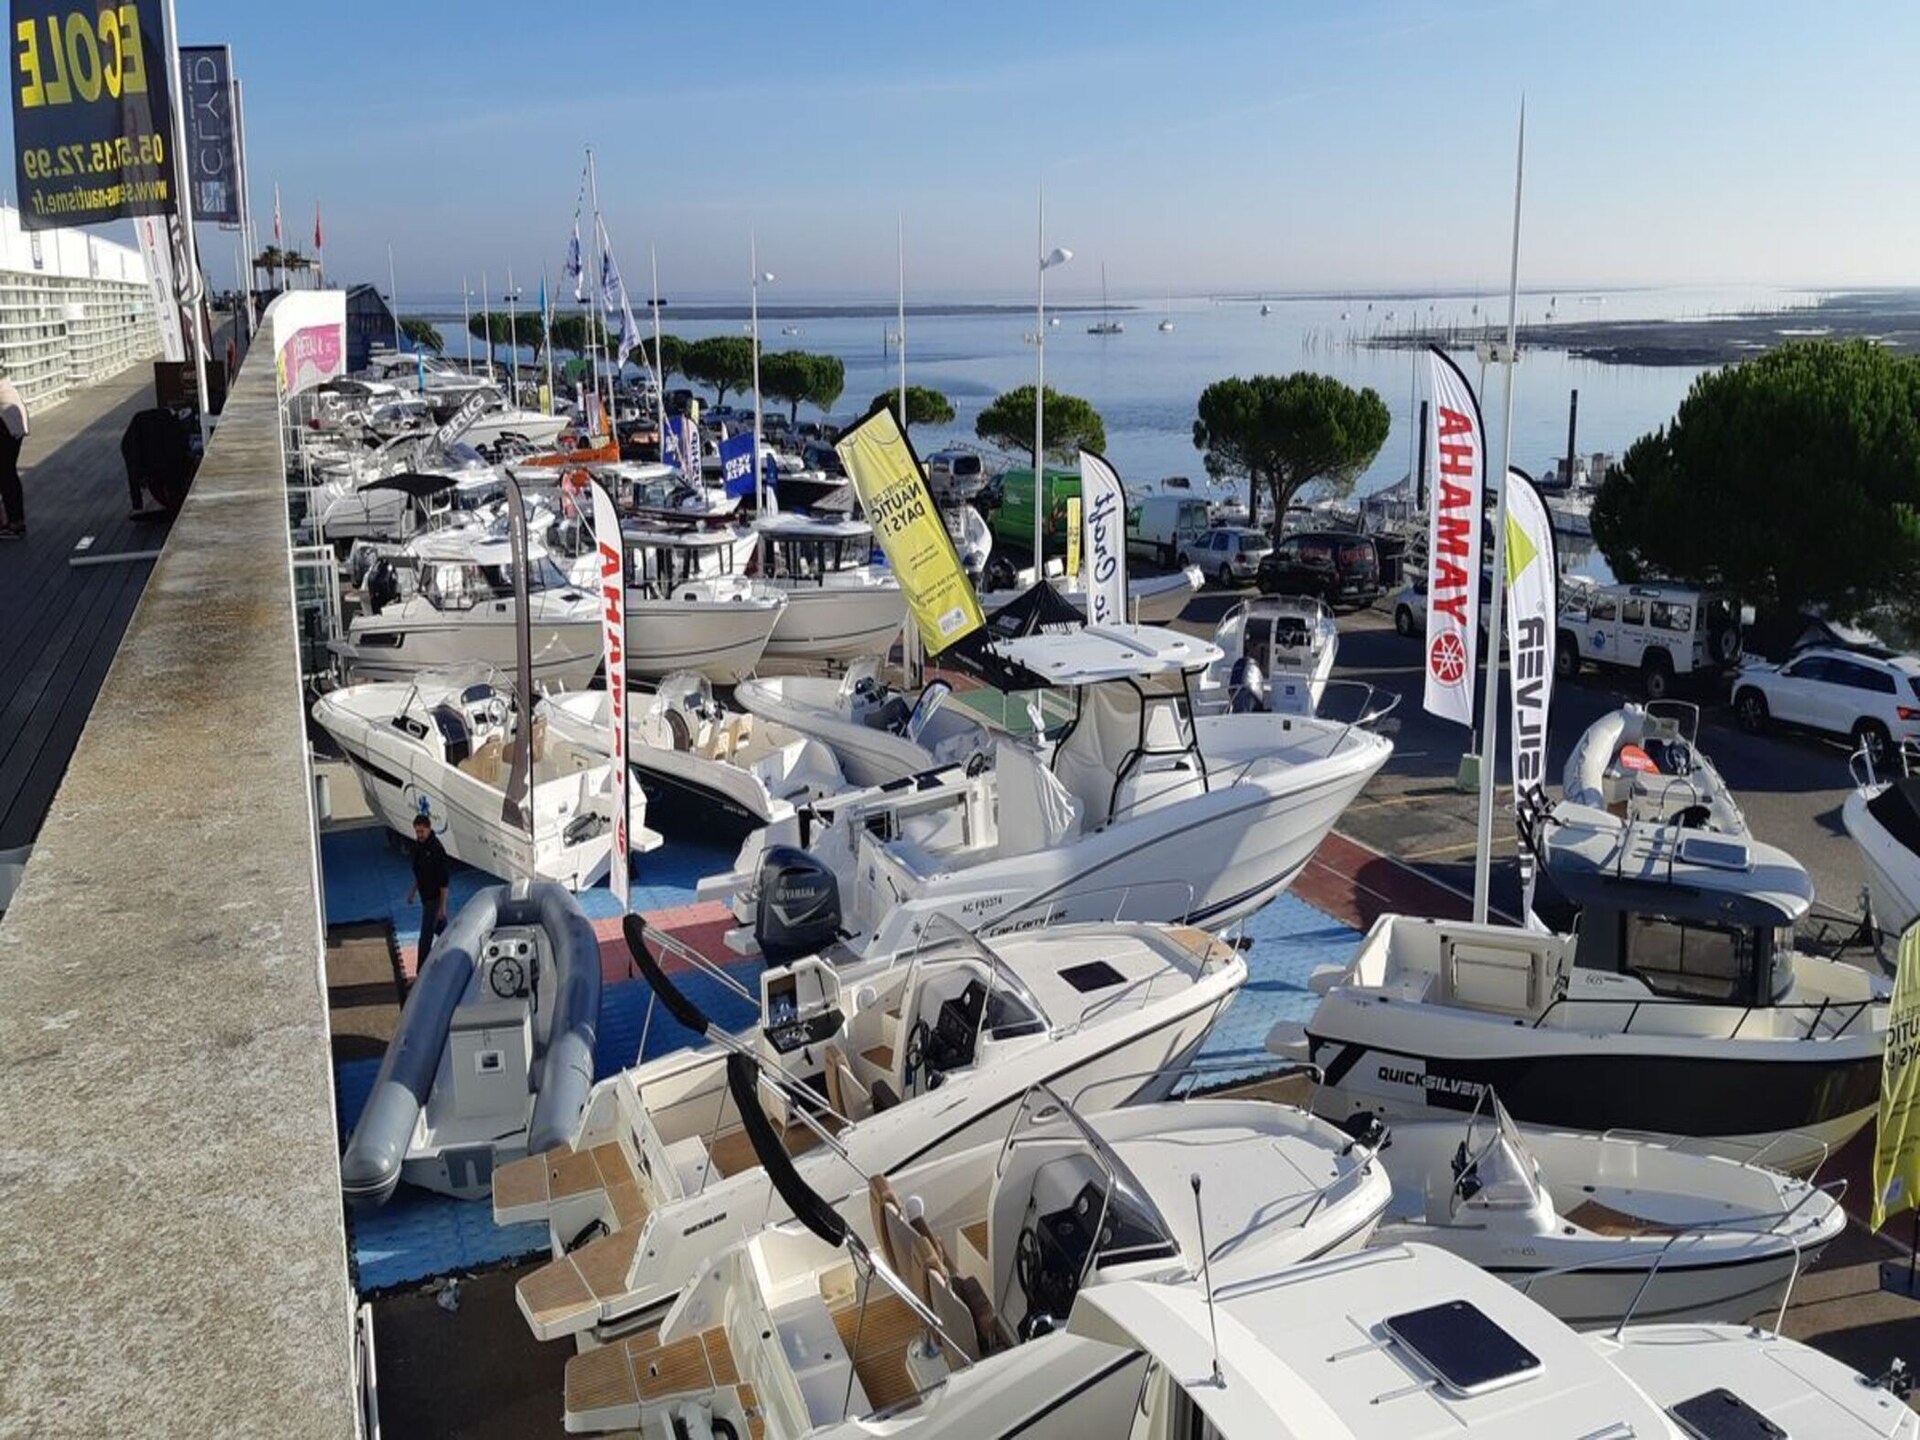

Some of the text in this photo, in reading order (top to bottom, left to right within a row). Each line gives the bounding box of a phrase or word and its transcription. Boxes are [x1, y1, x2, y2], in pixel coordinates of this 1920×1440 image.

[438, 392, 485, 443] BRIG
[786, 887, 815, 899] YAMAHA
[1378, 1066, 1485, 1097] QUICKSILVER
